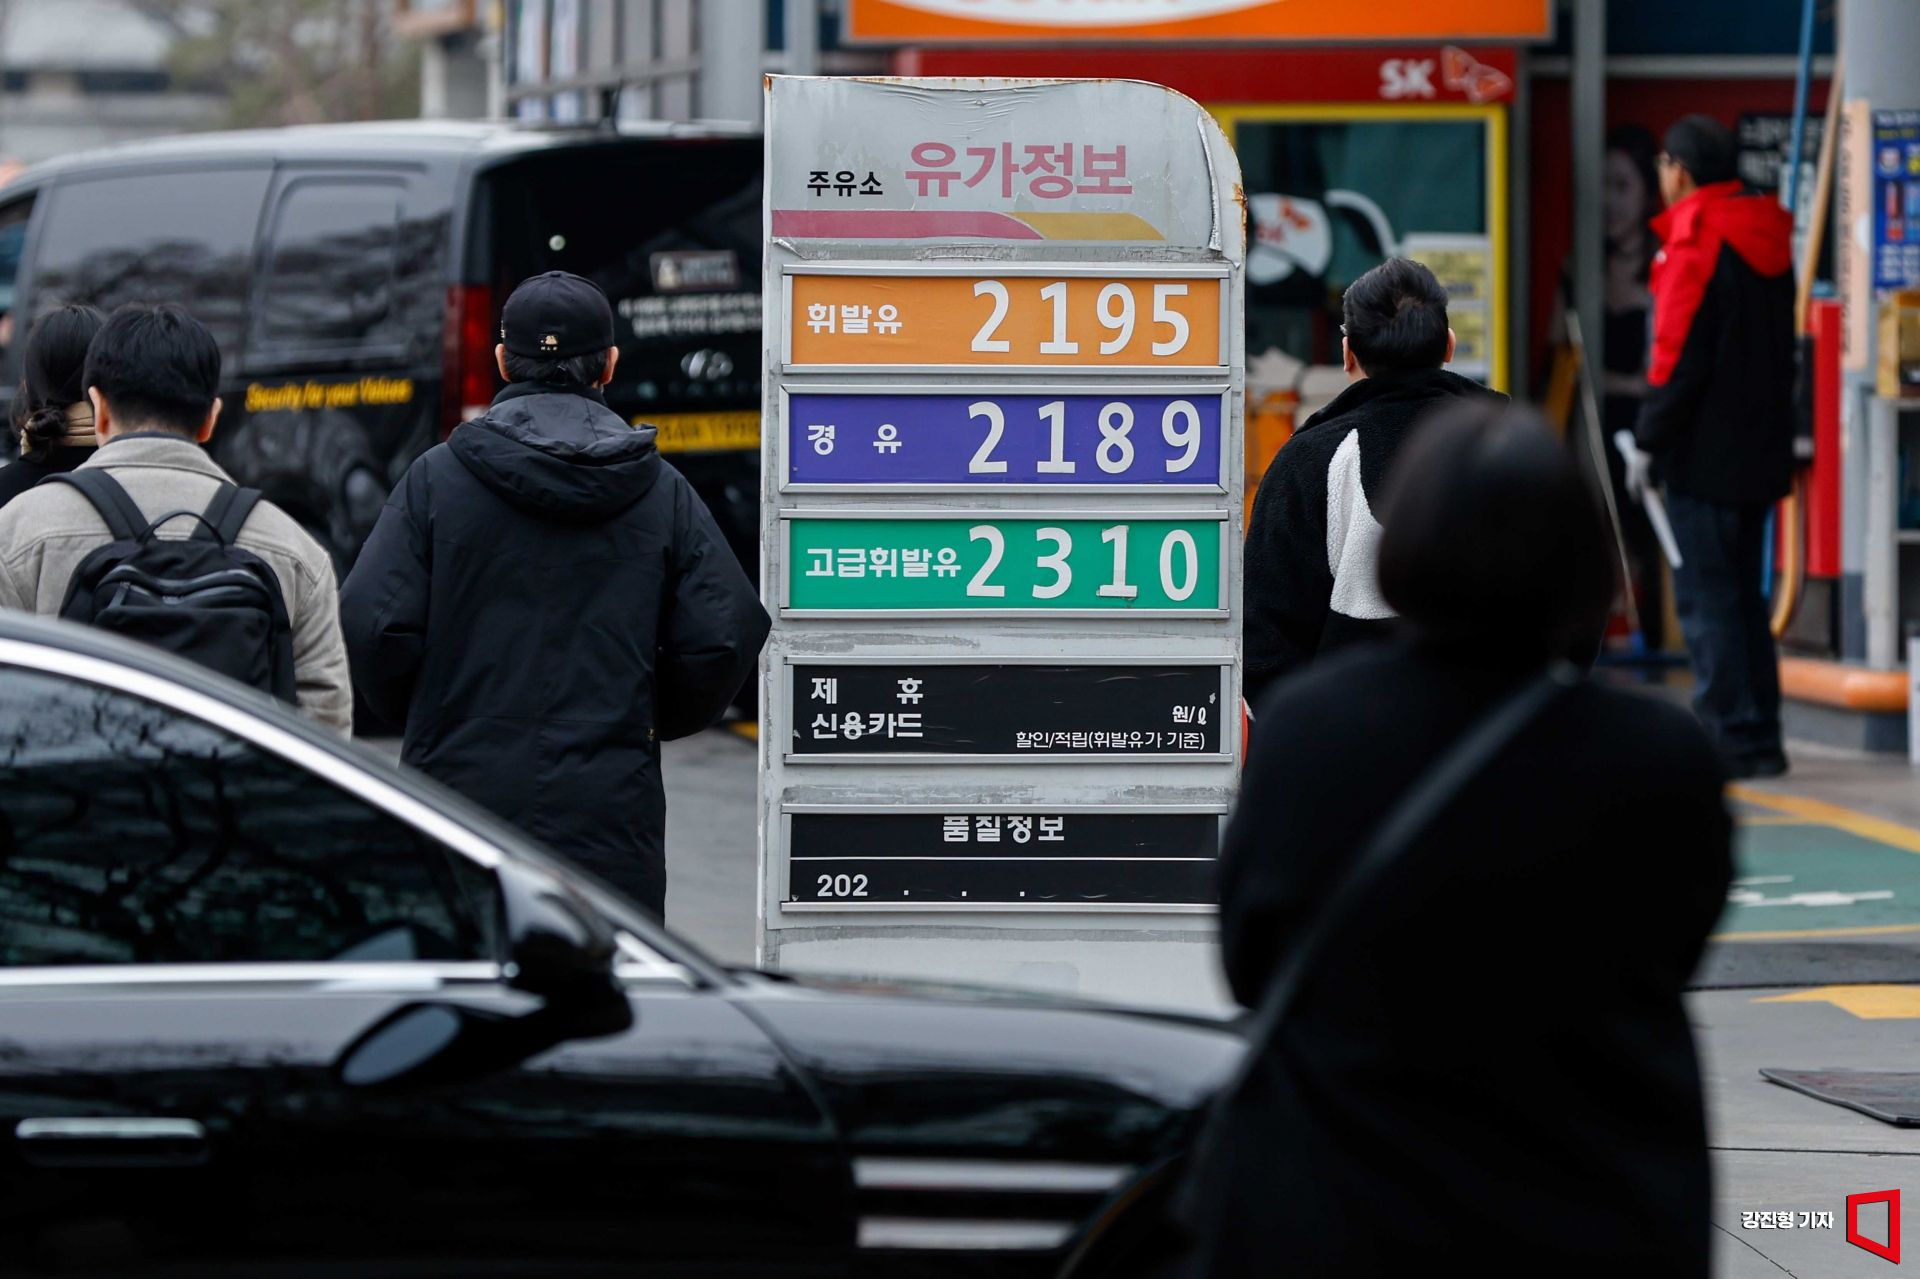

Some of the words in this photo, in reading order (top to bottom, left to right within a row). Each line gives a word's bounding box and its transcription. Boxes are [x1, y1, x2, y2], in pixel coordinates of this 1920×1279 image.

[1380, 59, 1435, 98] SK
[807, 171, 883, 196] 주유소
[905, 142, 1133, 199] 유가정보
[807, 303, 903, 334] 휘발유
[970, 280, 1190, 356] 2195
[807, 424, 836, 455] 경
[873, 424, 902, 454] 유
[967, 400, 1201, 474] 2189
[805, 547, 961, 578] 고급휘발유
[966, 525, 1199, 601] 2310
[811, 677, 838, 704] 제
[897, 677, 923, 704] 휴
[811, 712, 923, 740] 신용카드
[1015, 731, 1162, 749] 할인/적립(휘발유가
[1166, 732, 1206, 750] 기준)
[943, 816, 1065, 843] 품질정보
